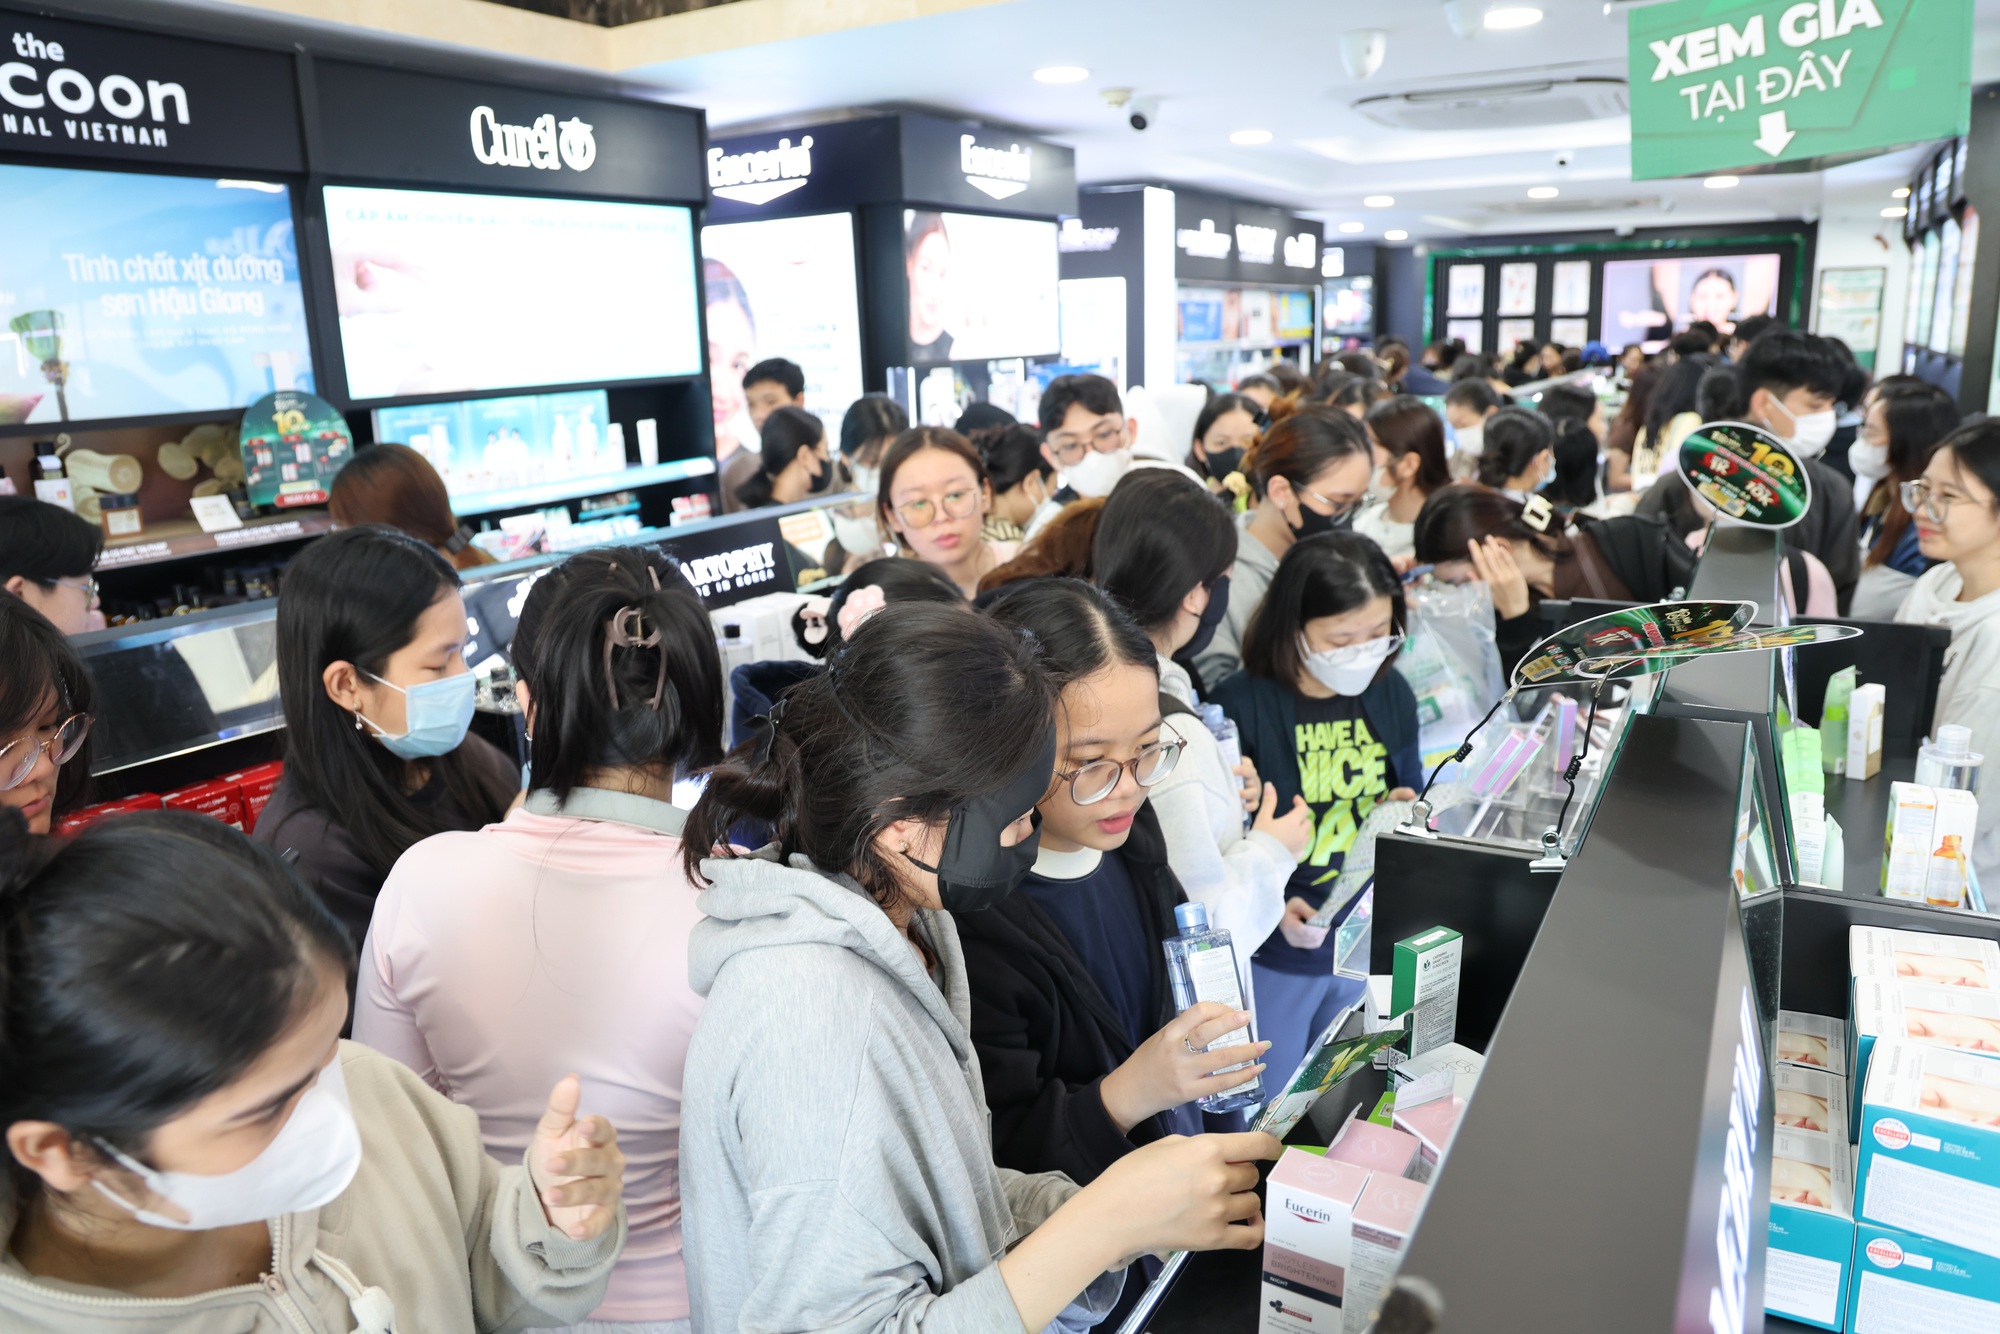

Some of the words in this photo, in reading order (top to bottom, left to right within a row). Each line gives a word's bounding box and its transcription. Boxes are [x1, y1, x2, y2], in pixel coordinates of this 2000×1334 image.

[12, 32, 65, 62] the
[1649, 14, 1766, 83] XEM
[1679, 75, 1746, 123] TẠI
[1755, 48, 1852, 105] ĐÂY
[63, 119, 168, 147] VIETNAM
[470, 106, 561, 170] Curél
[123, 251, 177, 283] chất
[182, 253, 209, 287] xịt
[212, 253, 284, 284] dưỡng
[102, 293, 147, 317] sen
[147, 287, 198, 320] Hậu
[200, 288, 265, 316] Giang
[1749, 441, 1795, 476] 10
[716, 579, 731, 593] IN
[735, 569, 775, 588] KOREA
[1295, 720, 1353, 753] HAVE
[1354, 718, 1374, 746] A
[1297, 742, 1388, 803] NICE
[1285, 1198, 1331, 1222] Eucerin
[1270, 1259, 1337, 1288] BRIGHTENING
[1271, 1251, 1321, 1274] SPOTLESS
[1269, 1276, 1289, 1287] NIGHT
